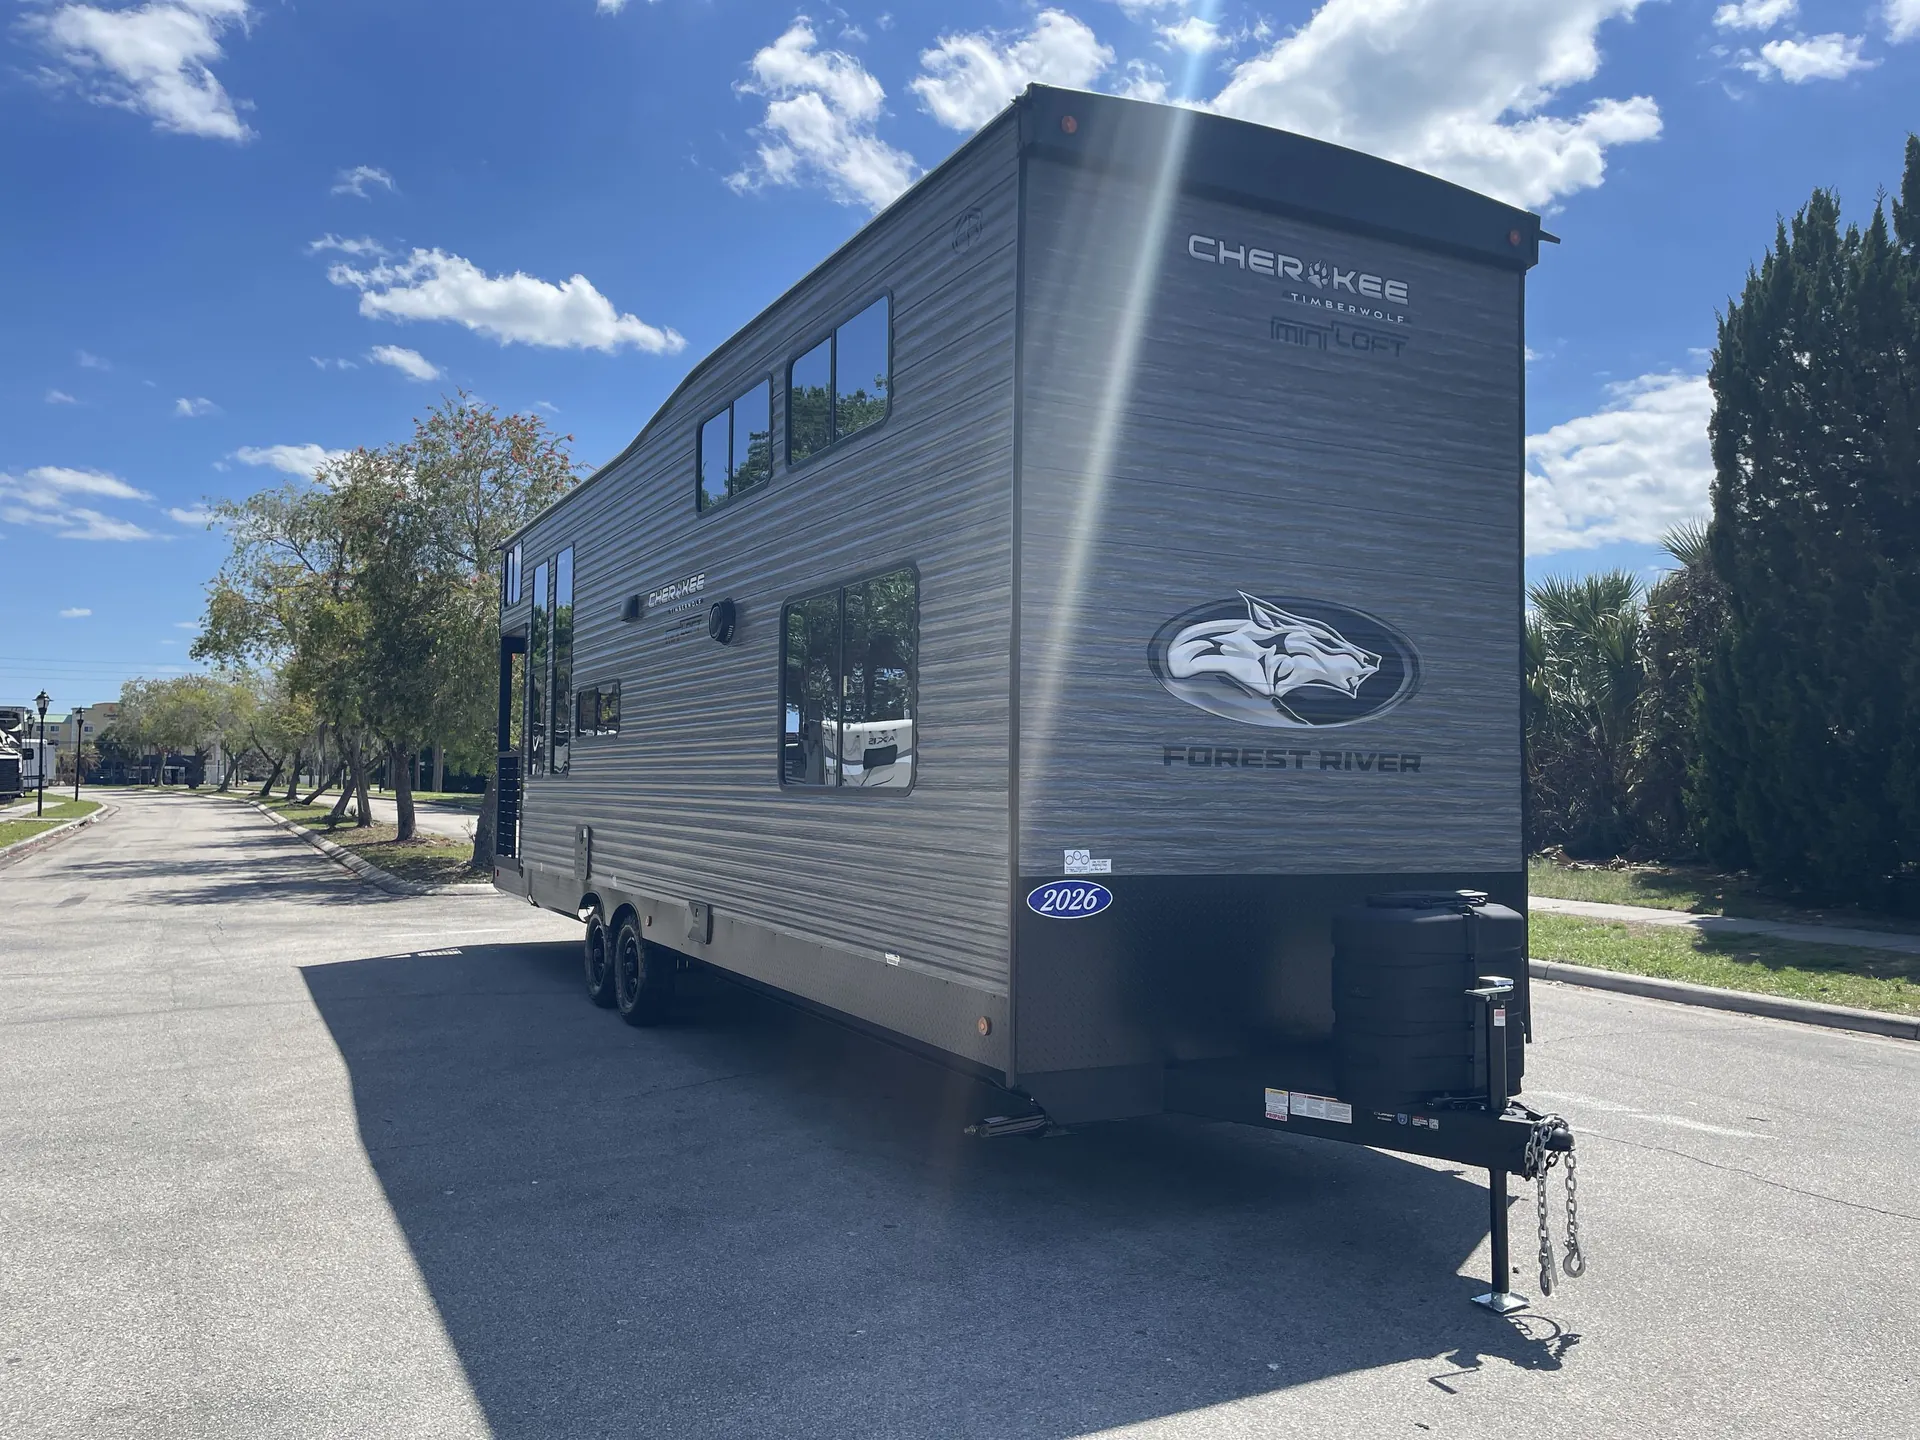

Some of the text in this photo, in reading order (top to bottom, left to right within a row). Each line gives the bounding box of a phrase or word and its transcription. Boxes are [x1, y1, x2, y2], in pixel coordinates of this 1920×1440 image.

[1291, 292, 1405, 324] TIMBERWOLF
[1335, 326, 1407, 357] LOFT
[1163, 745, 1422, 774] FOREST RIVER
[1040, 888, 1101, 912] 2026
